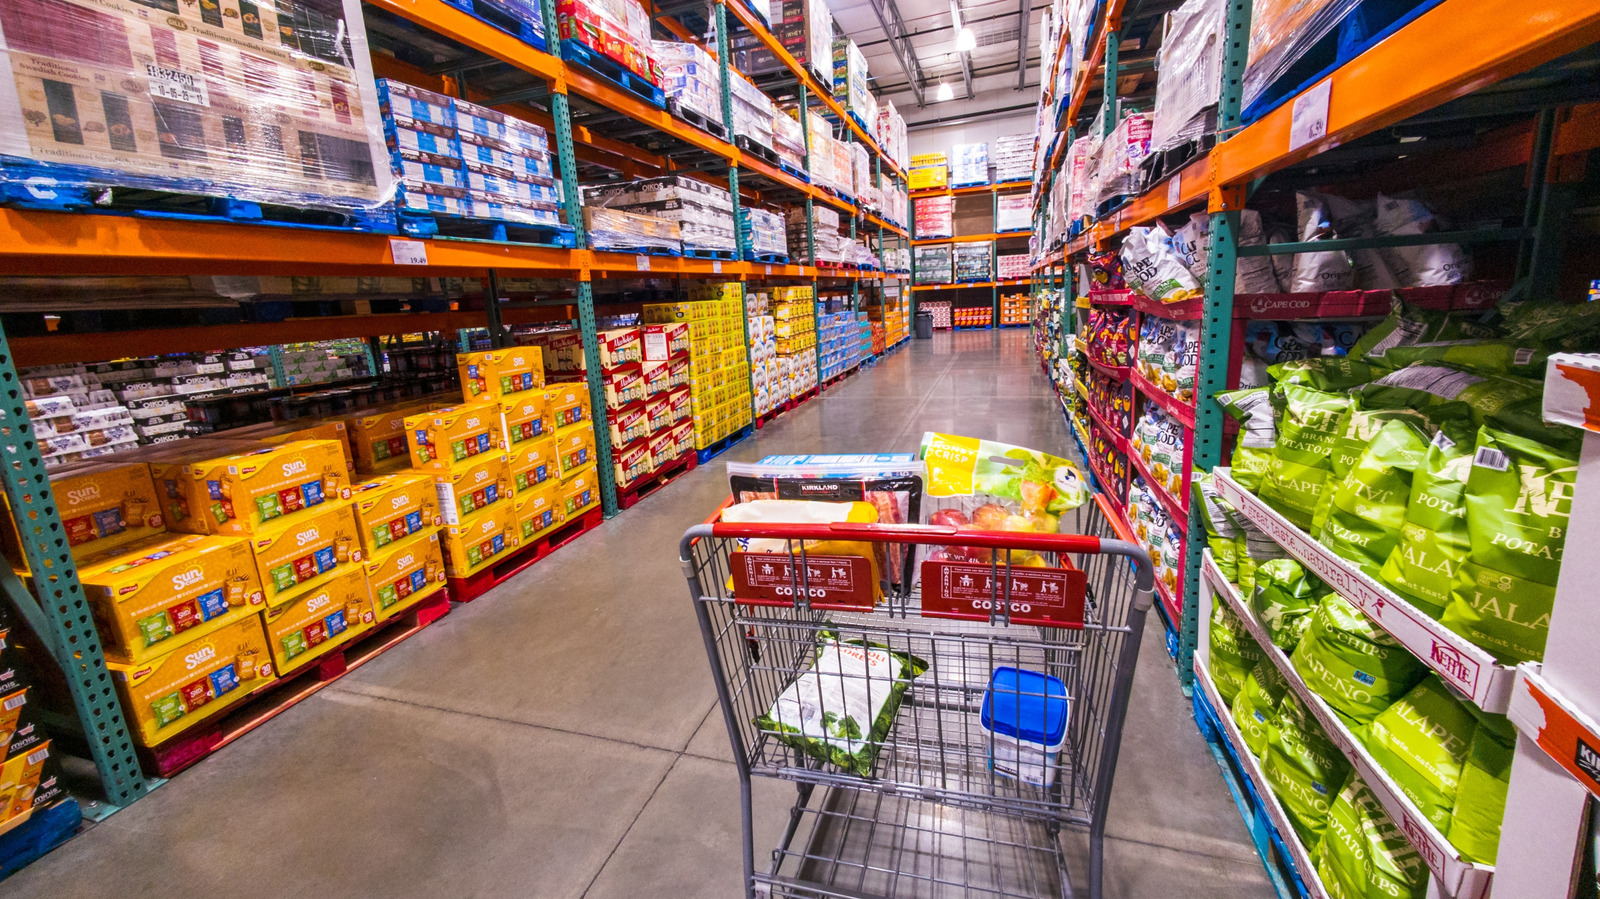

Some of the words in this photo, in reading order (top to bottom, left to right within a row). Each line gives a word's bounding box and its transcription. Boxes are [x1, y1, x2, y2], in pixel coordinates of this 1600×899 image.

[192, 26, 232, 43] Traditional
[233, 38, 260, 51] Swedish
[261, 47, 286, 58] Cookies
[19, 62, 57, 77] Swedish
[57, 70, 90, 82] Cookies
[31, 58, 78, 74] Traditional
[604, 188, 625, 196] OIKOS
[642, 182, 664, 192] OIKOS
[410, 256, 427, 264] 19.49
[1131, 256, 1153, 274] APE
[1264, 299, 1288, 309] CAPE
[1288, 299, 1310, 309] COD
[186, 377, 210, 385] OIKOS
[230, 372, 251, 380] OIKOS
[126, 382, 152, 391] OIKOS
[142, 399, 169, 409] OIKOS
[154, 434, 179, 444] OIKOS
[933, 440, 974, 456] HONEY
[1281, 437, 1321, 453] OTATO
[935, 450, 968, 463] CRISP
[282, 459, 306, 477] Sun
[67, 485, 99, 505] Sun
[1416, 492, 1465, 519] POTA
[296, 528, 319, 546] Sun
[1491, 532, 1563, 561] POTA
[171, 568, 203, 591] Sun
[307, 594, 330, 613] Sun
[1470, 591, 1552, 630] JALA
[1337, 632, 1389, 660] CHIPS
[1471, 630, 1509, 648] great
[1513, 643, 1542, 659] tast
[185, 646, 215, 670] Sun
[1431, 638, 1472, 687] KETTLE
[11, 734, 36, 751] minis
[35, 787, 58, 804] minis
[1402, 812, 1441, 870] KETTLE
